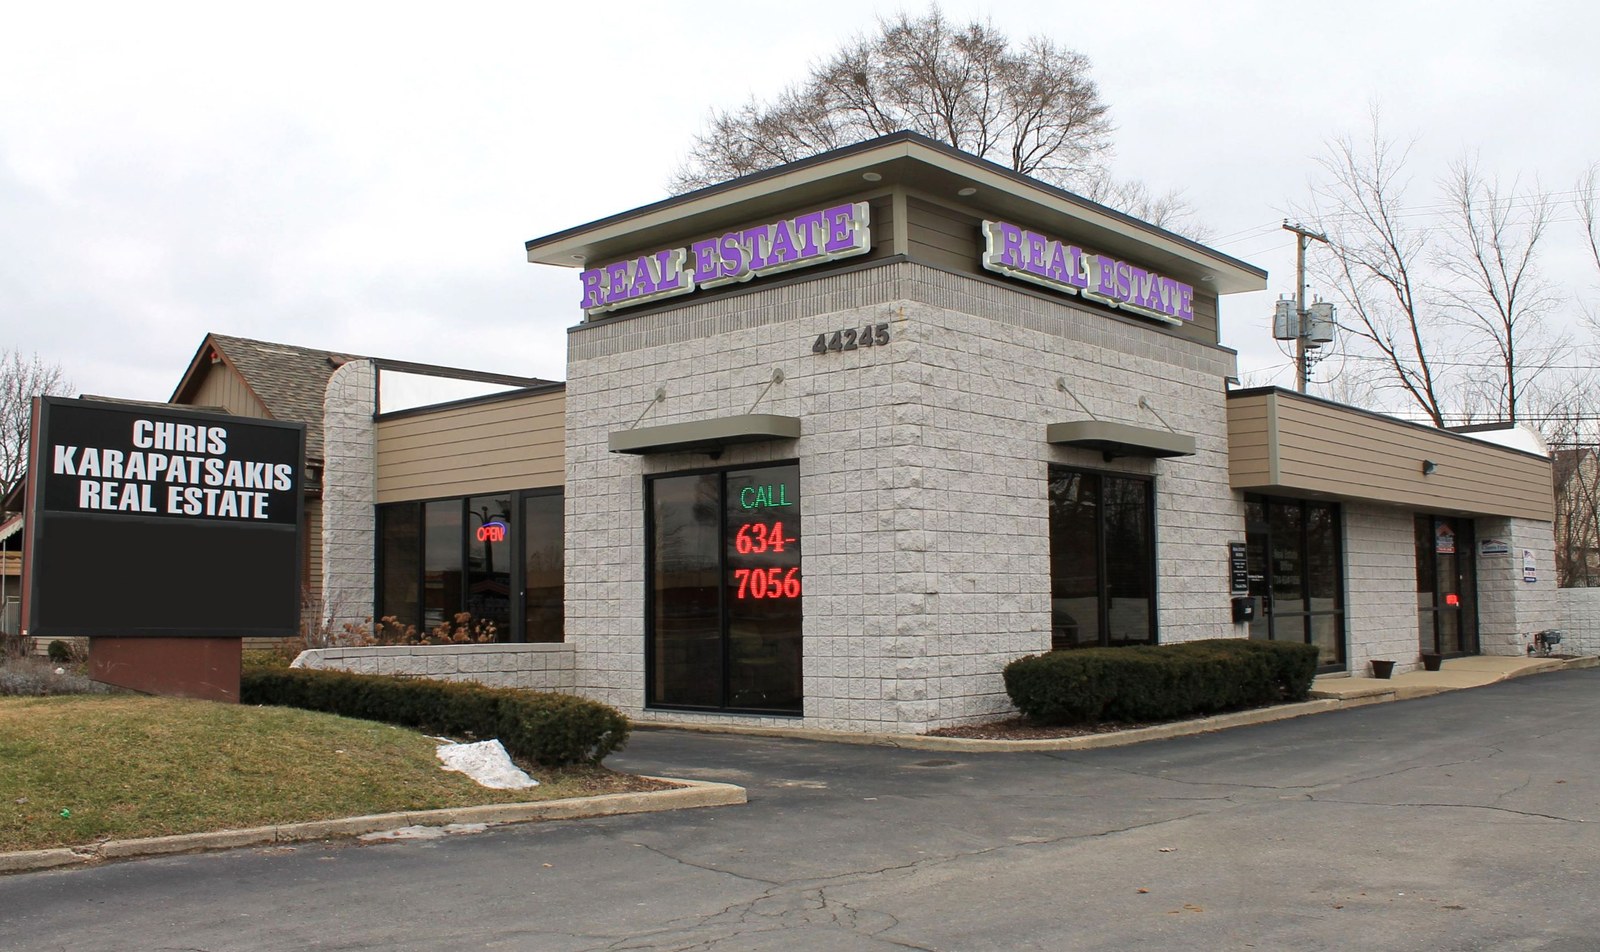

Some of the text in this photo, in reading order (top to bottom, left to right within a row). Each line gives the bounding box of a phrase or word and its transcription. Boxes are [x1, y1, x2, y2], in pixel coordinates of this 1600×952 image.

[580, 202, 857, 310] REAL ESTATE
[998, 221, 1194, 321] REAL ESTATE
[812, 323, 890, 355] 44245
[132, 418, 227, 455] CHRIS
[53, 444, 293, 491] KARAPATSAKIS
[78, 479, 269, 519] REAL ESTATE
[740, 483, 793, 509] CALL
[476, 526, 504, 541] OPEN
[735, 521, 796, 554] 634-
[735, 566, 800, 599] 7056
